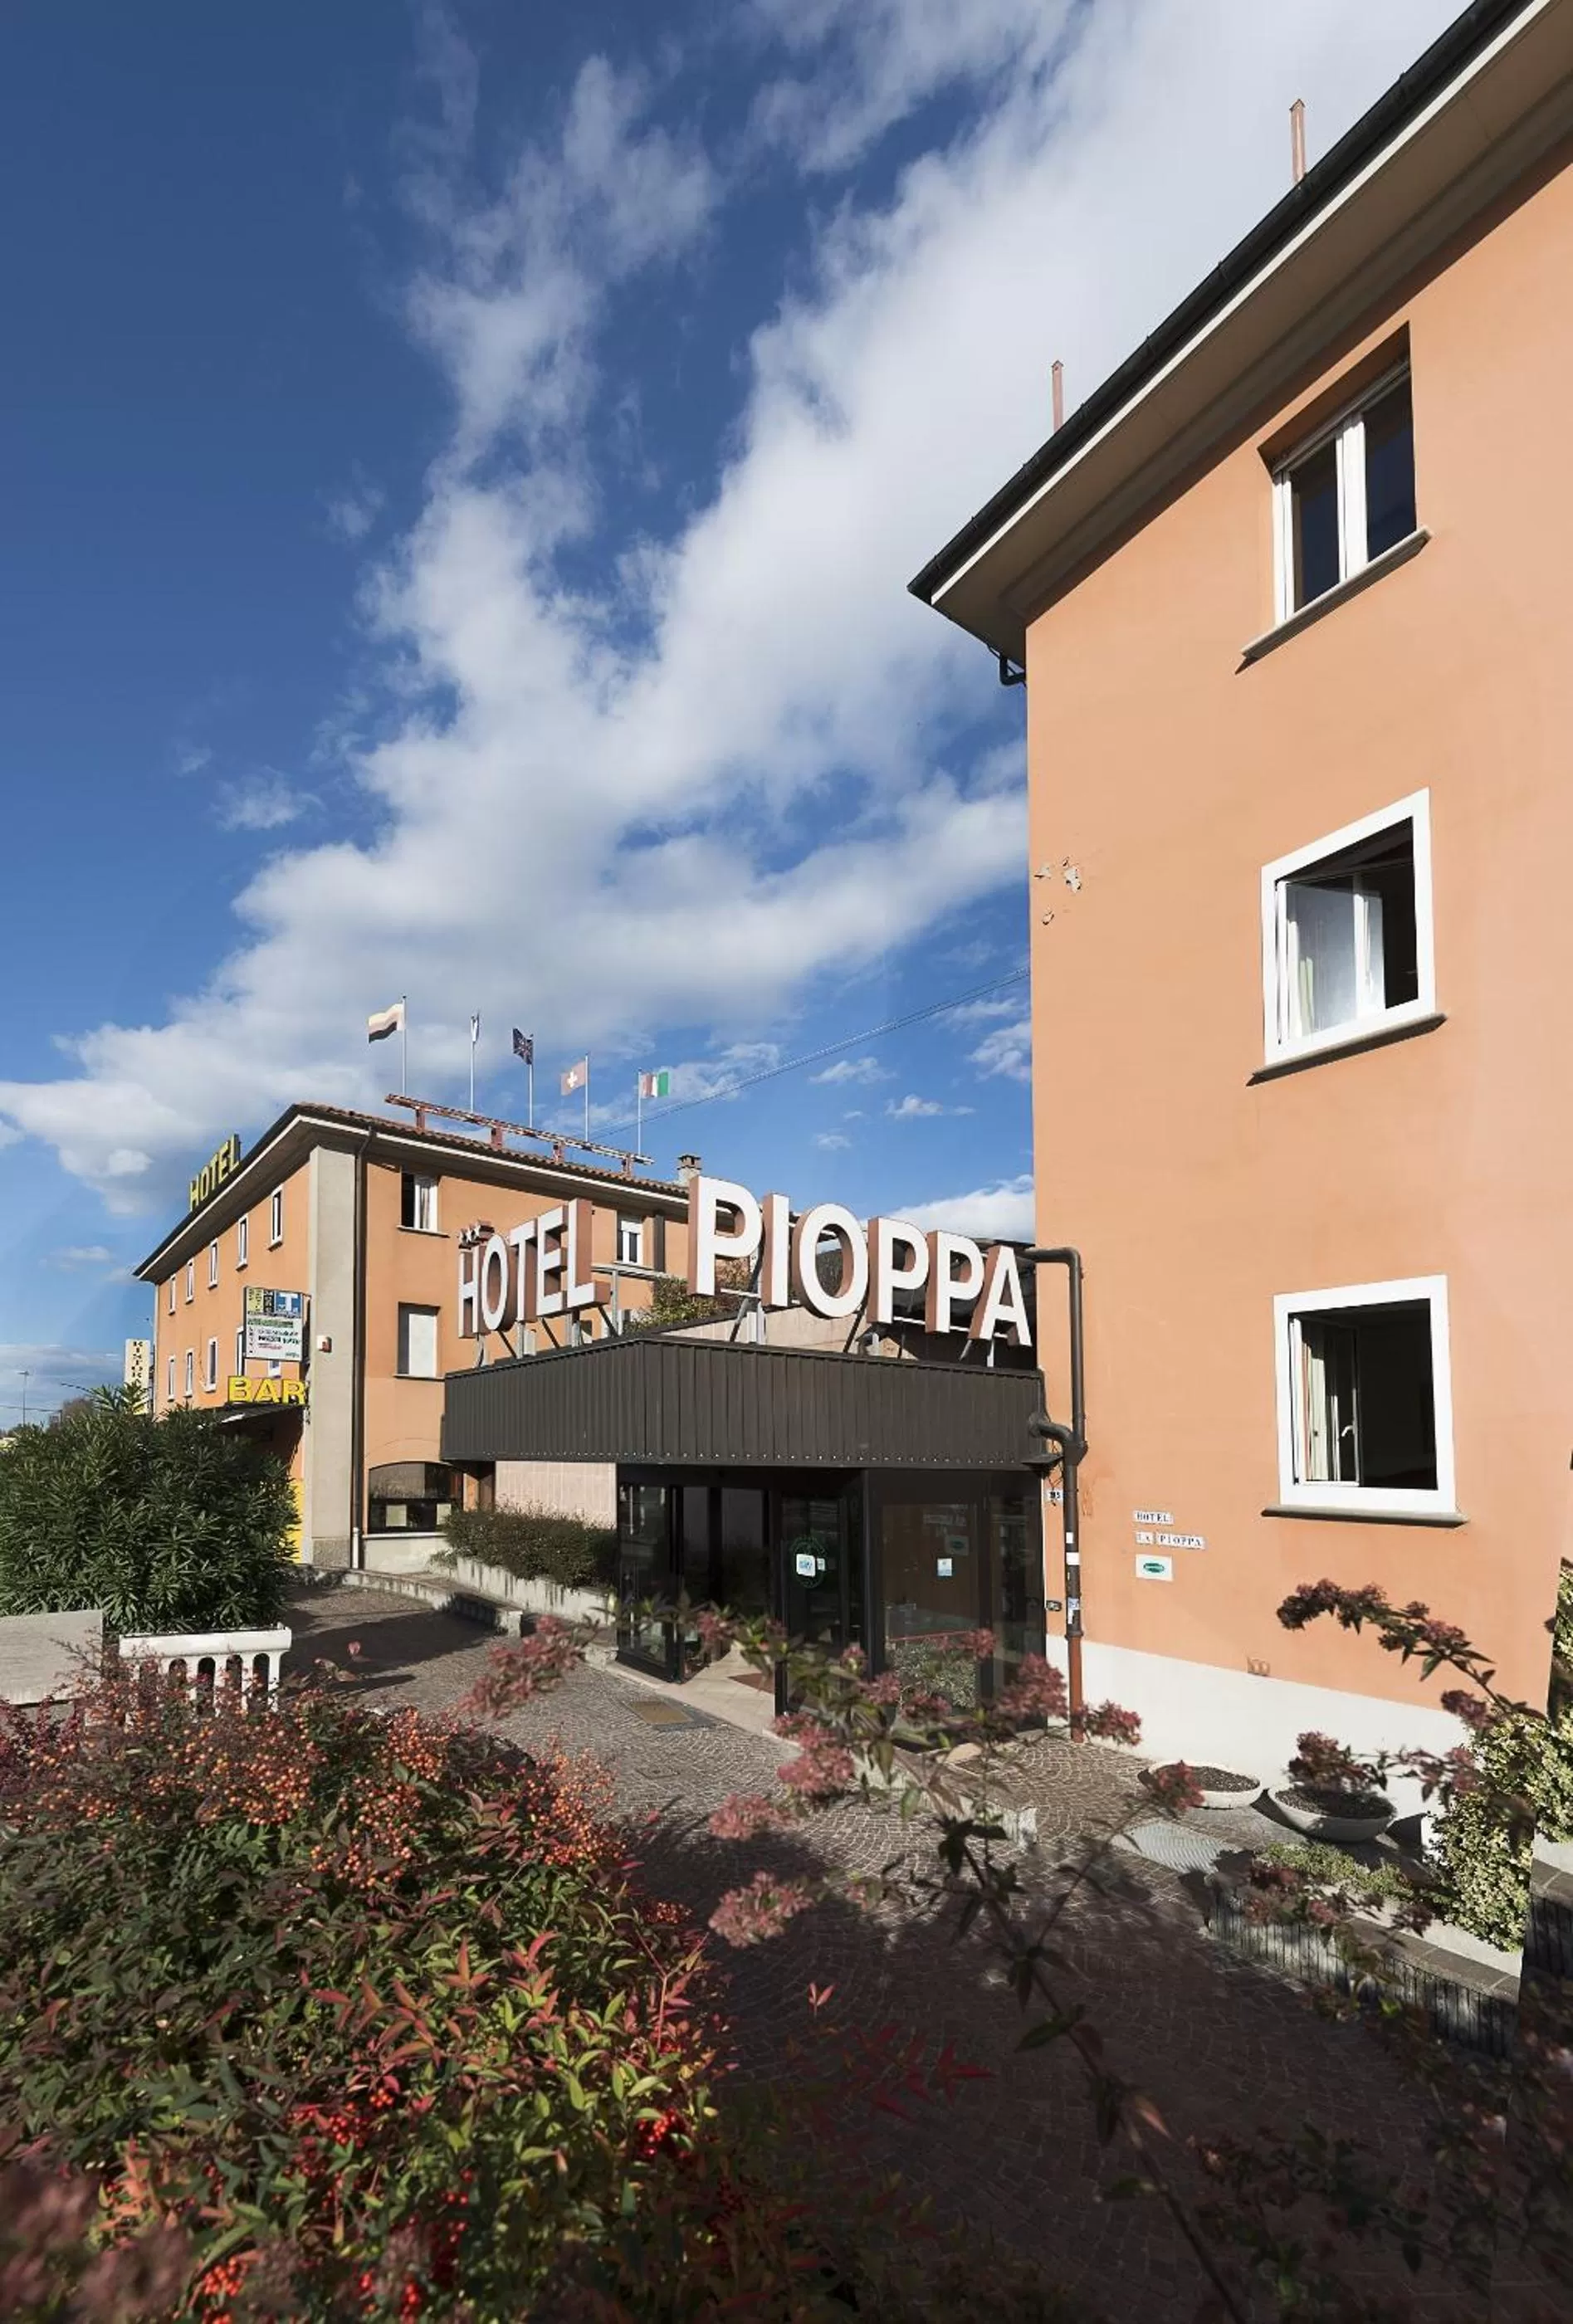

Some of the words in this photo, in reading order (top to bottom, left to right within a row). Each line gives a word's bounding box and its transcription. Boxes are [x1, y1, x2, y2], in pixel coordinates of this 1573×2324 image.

[188, 1134, 242, 1212] HOTEL
[458, 1198, 610, 1338] HOTEL
[687, 1175, 1032, 1346] PIOPPA
[227, 1375, 308, 1405] BAR
[1136, 1511, 1169, 1522] HOTEL
[1160, 1535, 1202, 1546] PIOPPA
